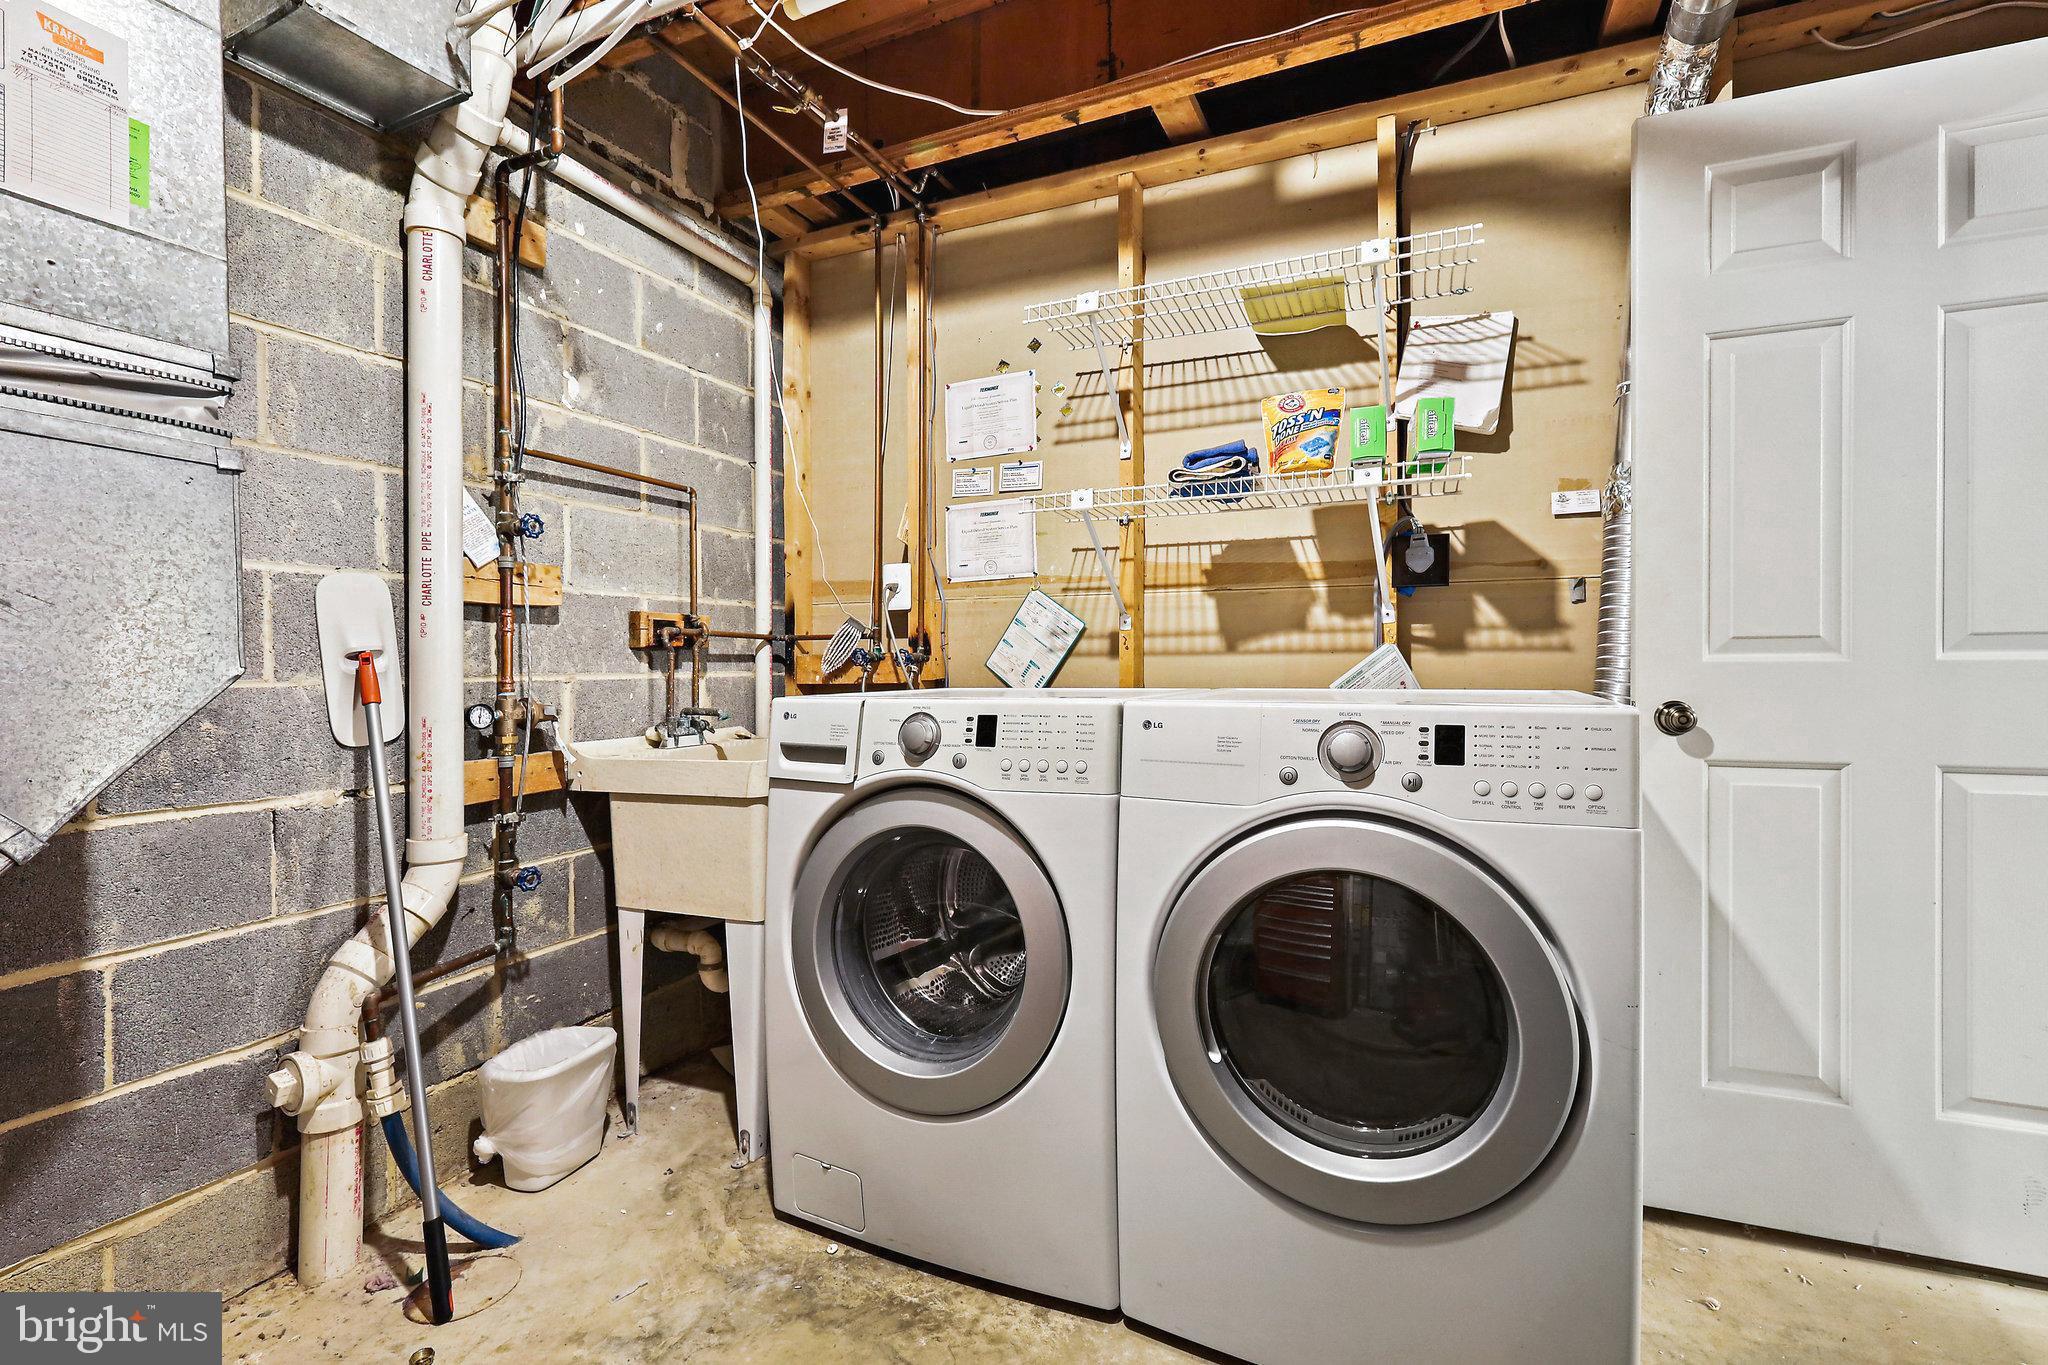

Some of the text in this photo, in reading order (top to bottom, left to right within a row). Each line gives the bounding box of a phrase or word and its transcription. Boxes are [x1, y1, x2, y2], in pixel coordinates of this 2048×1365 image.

[21, 49, 66, 73] 751-7510
[28, 47, 76, 71] MAINTENANCE
[79, 69, 114, 87] CONTRACTS
[54, 51, 101, 75] CONDITIONING
[57, 47, 86, 63] HEATING
[33, 61, 66, 78] CLEANERS
[421, 231, 433, 281] CHARLOTTE
[1271, 413, 1306, 441] TOSS
[1275, 424, 1301, 447] DONE
[1360, 418, 1370, 445] affresh
[1427, 409, 1439, 439] affresh
[421, 531, 432, 551] PIPE
[421, 557, 432, 607] CHARLOTTE
